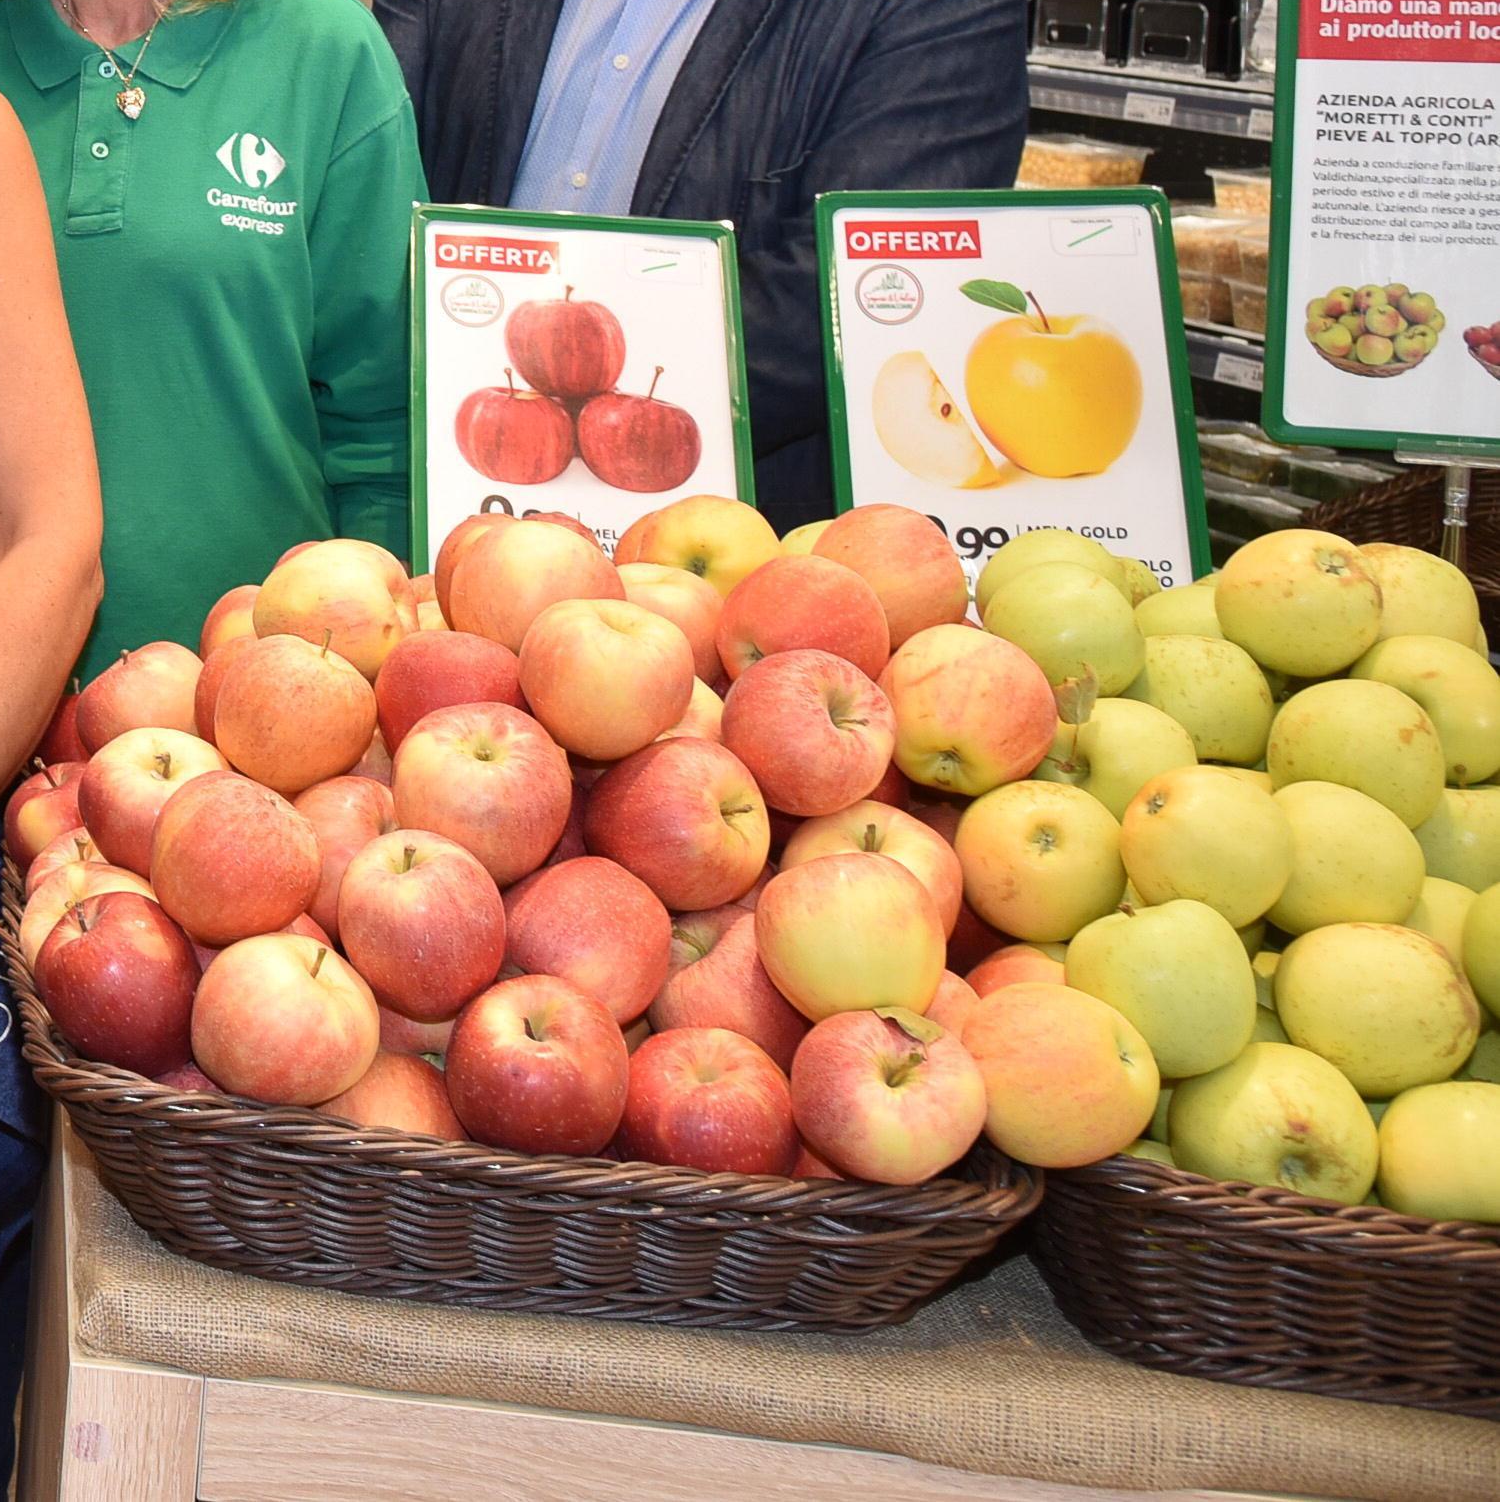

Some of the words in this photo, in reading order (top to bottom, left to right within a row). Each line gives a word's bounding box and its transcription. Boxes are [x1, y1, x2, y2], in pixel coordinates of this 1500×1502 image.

[1399, 0, 1442, 16] una
[1448, 0, 1500, 17] man
[1319, 18, 1341, 38] ai
[1347, 19, 1462, 42] produttori
[1316, 94, 1397, 108] AZIENDA
[1401, 95, 1496, 111] AGRICOLA
[1410, 113, 1422, 127] &
[1316, 129, 1367, 143] PIEVE
[1372, 130, 1396, 143] AL
[1400, 131, 1463, 146] TOPPO
[1313, 157, 1360, 169] Azienda
[1362, 160, 1369, 169] a
[1371, 159, 1440, 171] conduzione
[1457, 177, 1488, 187] nella
[1312, 186, 1358, 199] periodo
[1360, 188, 1396, 199] estivo
[1407, 189, 1420, 199] di
[1422, 191, 1451, 201] mele
[206, 188, 298, 217] Carrefour
[220, 213, 286, 237] express
[1311, 214, 1387, 227] distribuzione
[1389, 218, 1408, 228] dal
[1409, 220, 1449, 231] campo
[1451, 221, 1473, 230] alla
[848, 230, 978, 253] OFFERTA
[1320, 228, 1331, 239] la
[437, 243, 557, 269] OFFERTA
[588, 528, 620, 540] MEL
[1080, 526, 1129, 540] GOLD
